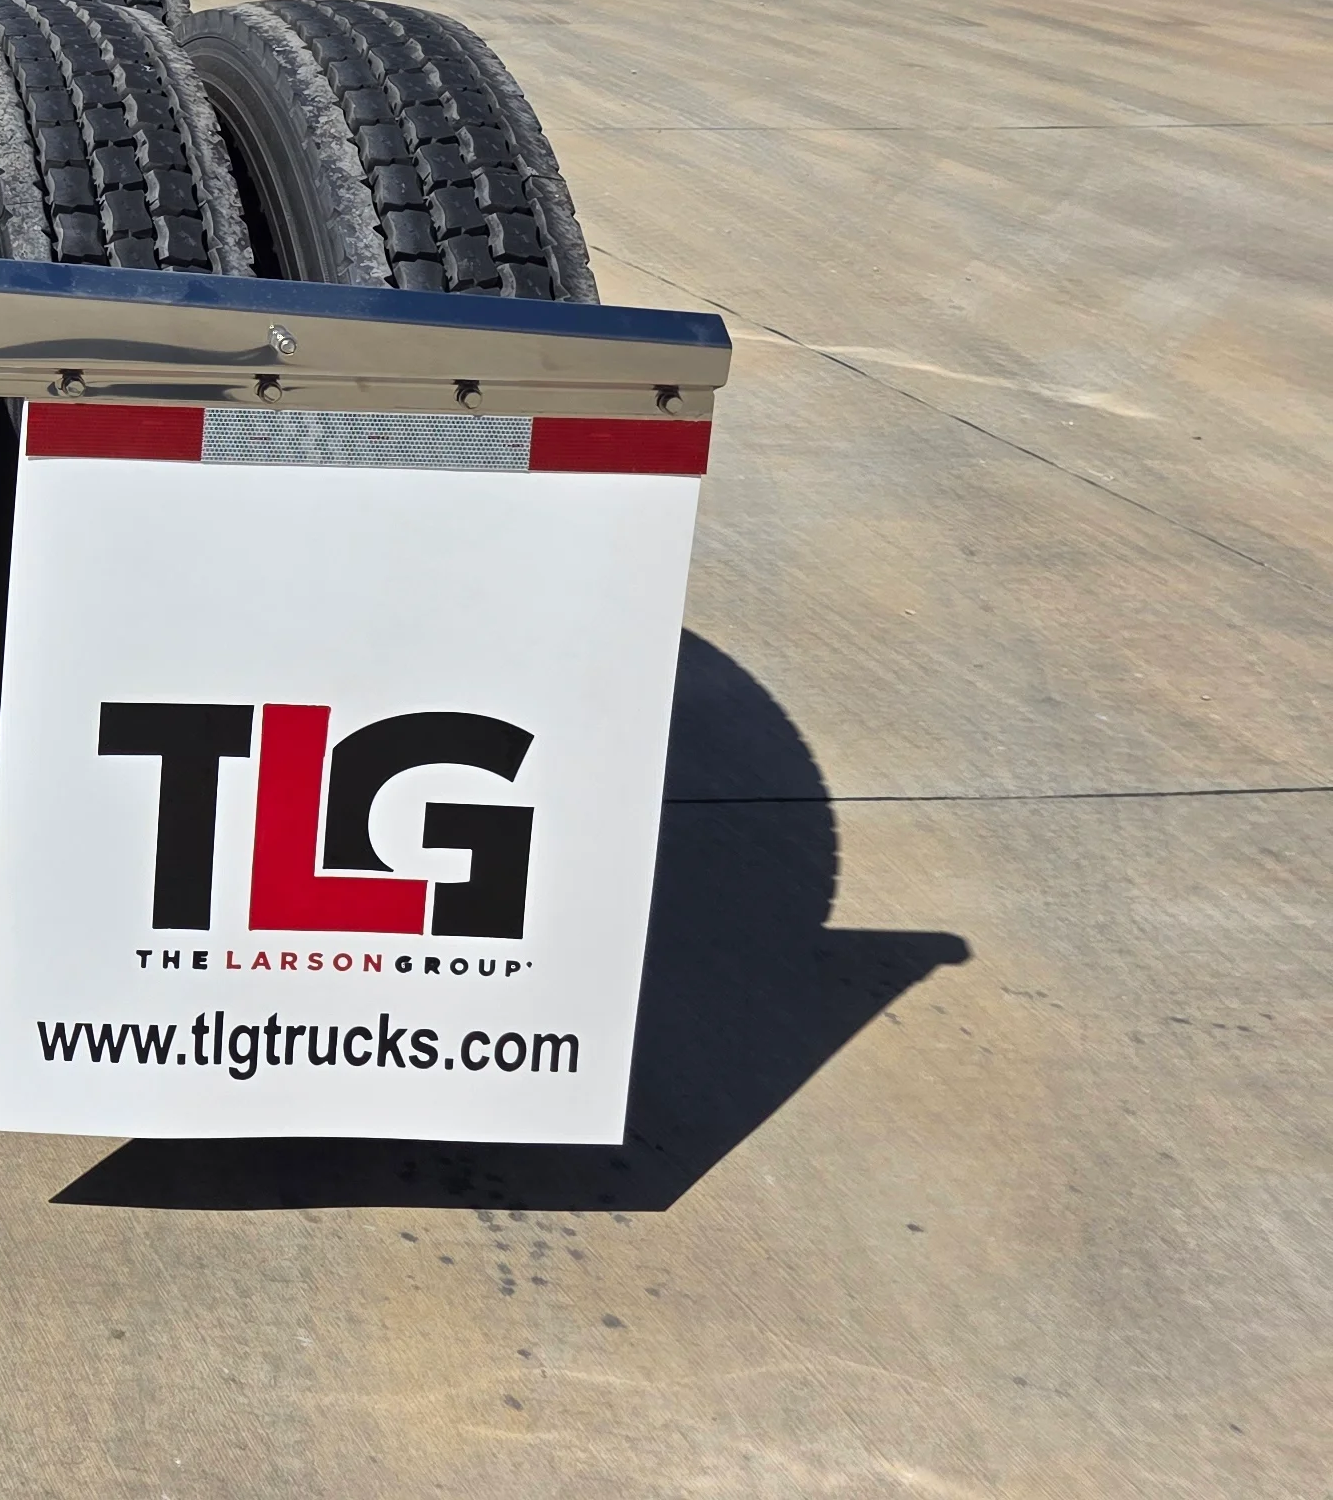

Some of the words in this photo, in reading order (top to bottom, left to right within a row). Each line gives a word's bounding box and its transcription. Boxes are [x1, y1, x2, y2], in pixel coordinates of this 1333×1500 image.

[97, 701, 535, 940] TLG
[135, 949, 210, 971] THE
[225, 950, 383, 974] LARSON
[394, 955, 522, 979] GROUP
[35, 1009, 580, 1082] www.tlgtrucks.com
